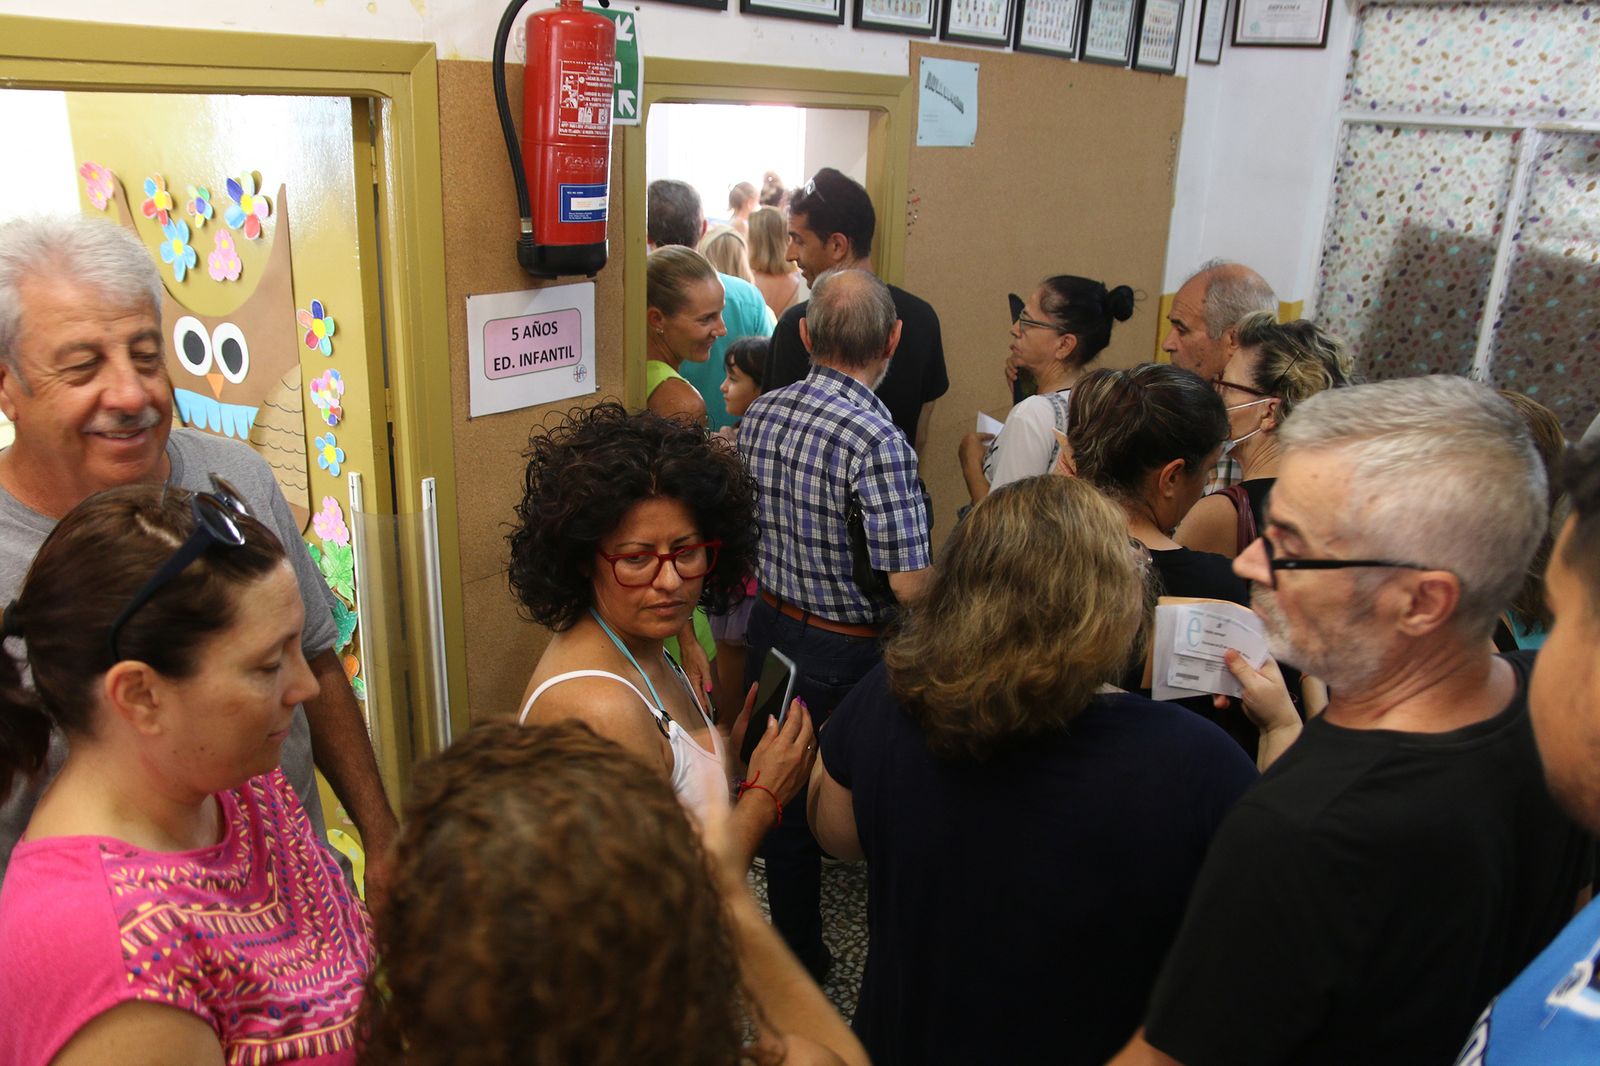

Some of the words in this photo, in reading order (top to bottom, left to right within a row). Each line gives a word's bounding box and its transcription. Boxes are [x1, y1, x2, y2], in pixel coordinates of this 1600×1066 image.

[511, 327, 519, 341] 5
[523, 320, 558, 339] AÑOS
[494, 356, 515, 372] ED.
[520, 345, 575, 367] INFANTIL
